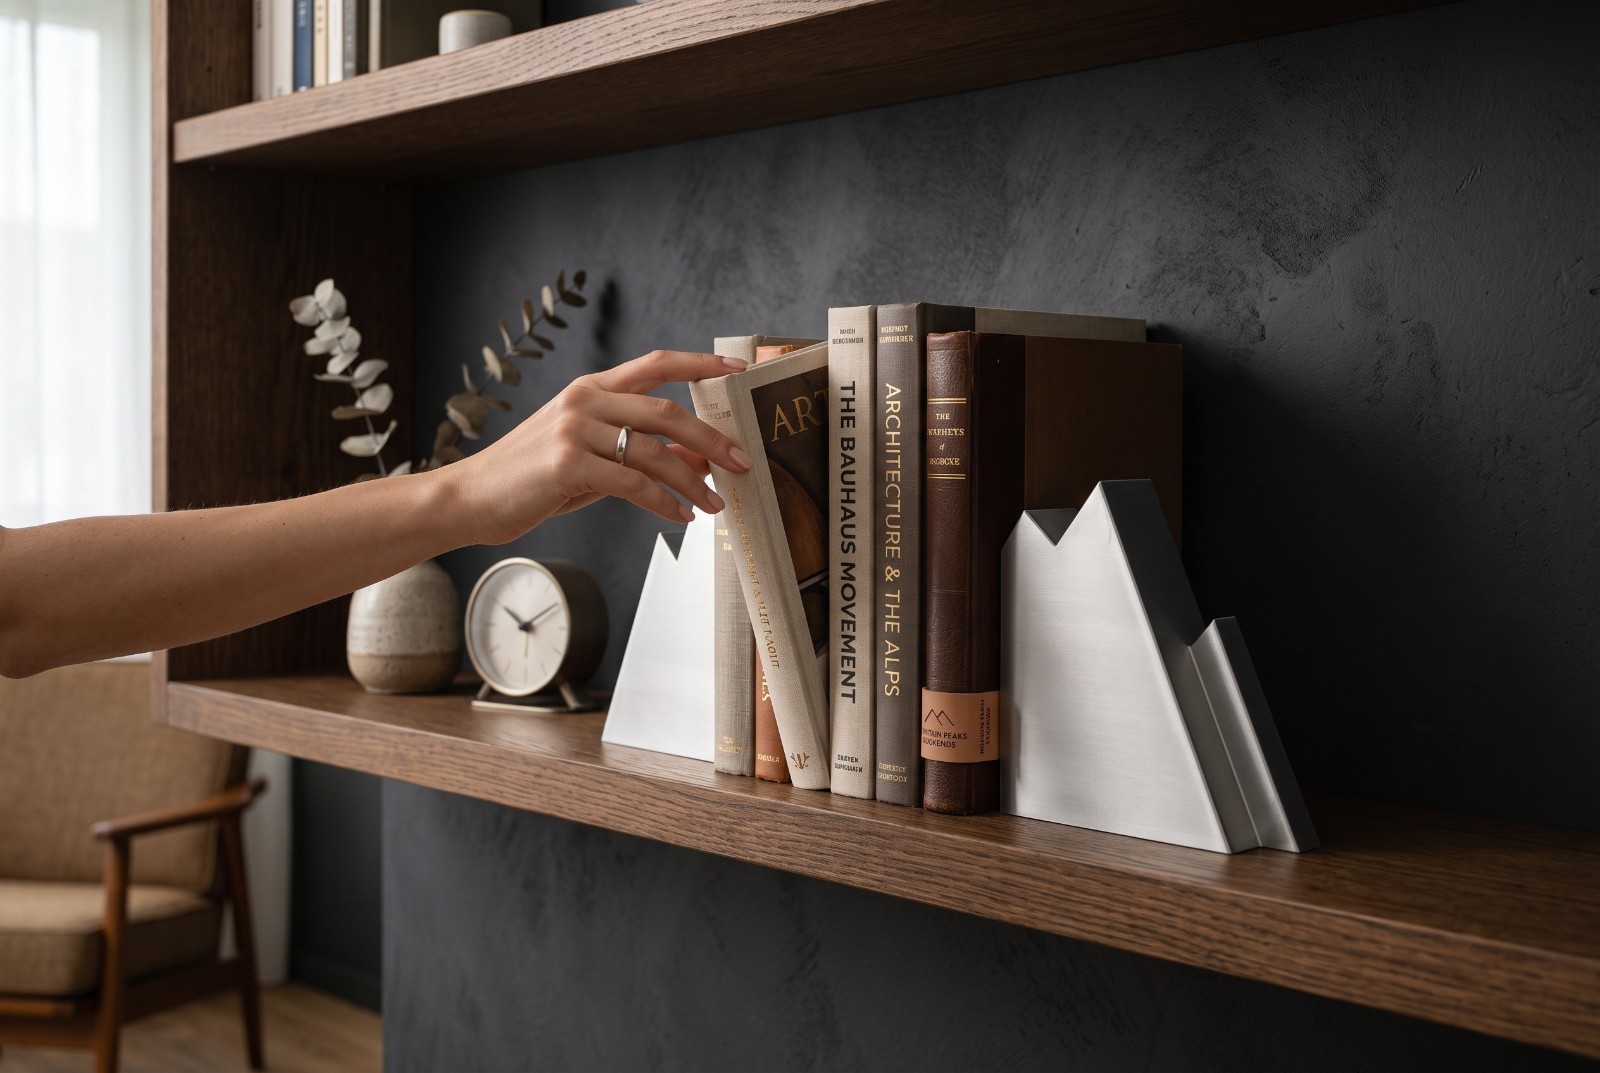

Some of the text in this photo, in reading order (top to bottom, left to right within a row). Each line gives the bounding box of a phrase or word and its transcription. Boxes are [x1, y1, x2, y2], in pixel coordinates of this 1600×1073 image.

[935, 412, 951, 420] THE
[839, 381, 857, 704] THE BAUHAUS MOVEMENT
[884, 383, 902, 696] ARCHITECTURE & THE ALPS
[943, 732, 968, 740] PEAKS
